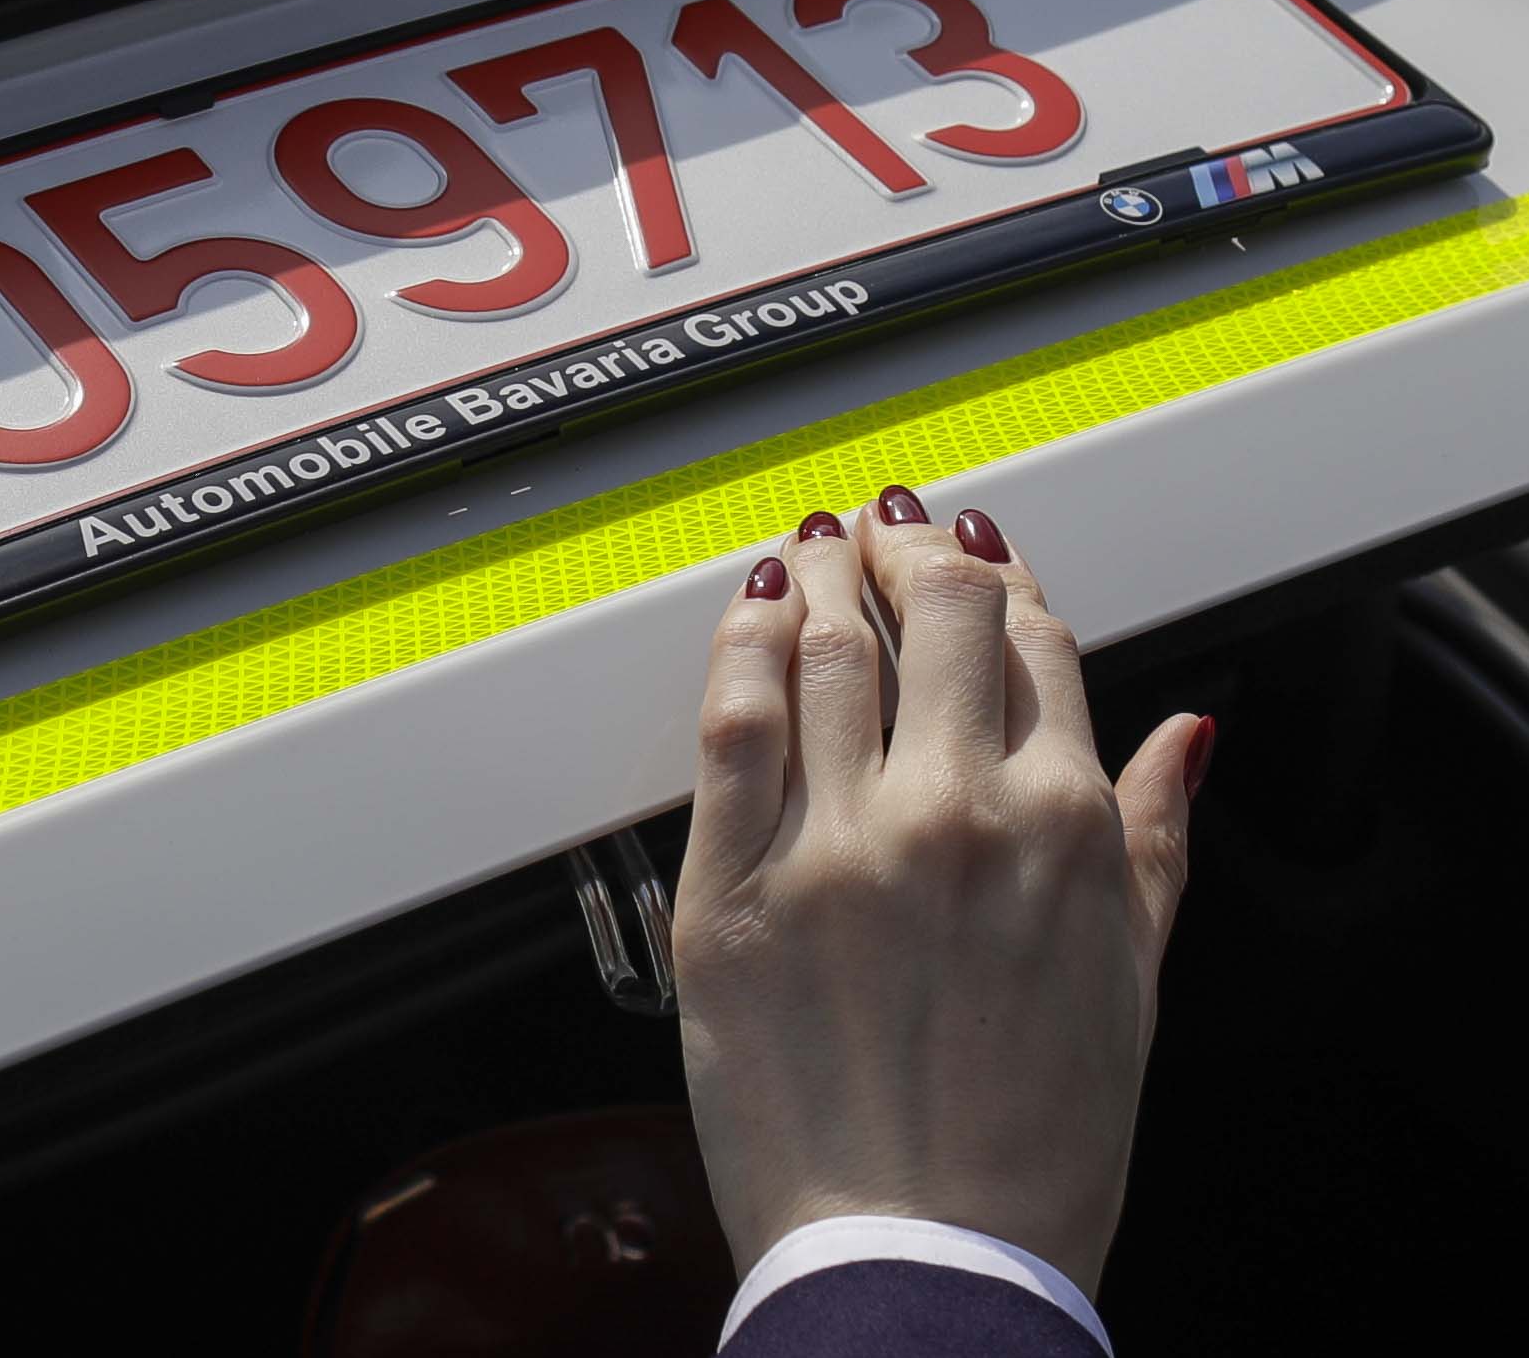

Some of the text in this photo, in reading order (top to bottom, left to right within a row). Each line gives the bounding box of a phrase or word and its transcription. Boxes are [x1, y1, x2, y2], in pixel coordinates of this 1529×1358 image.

[76, 278, 870, 559] Automobile Bavaria Group
